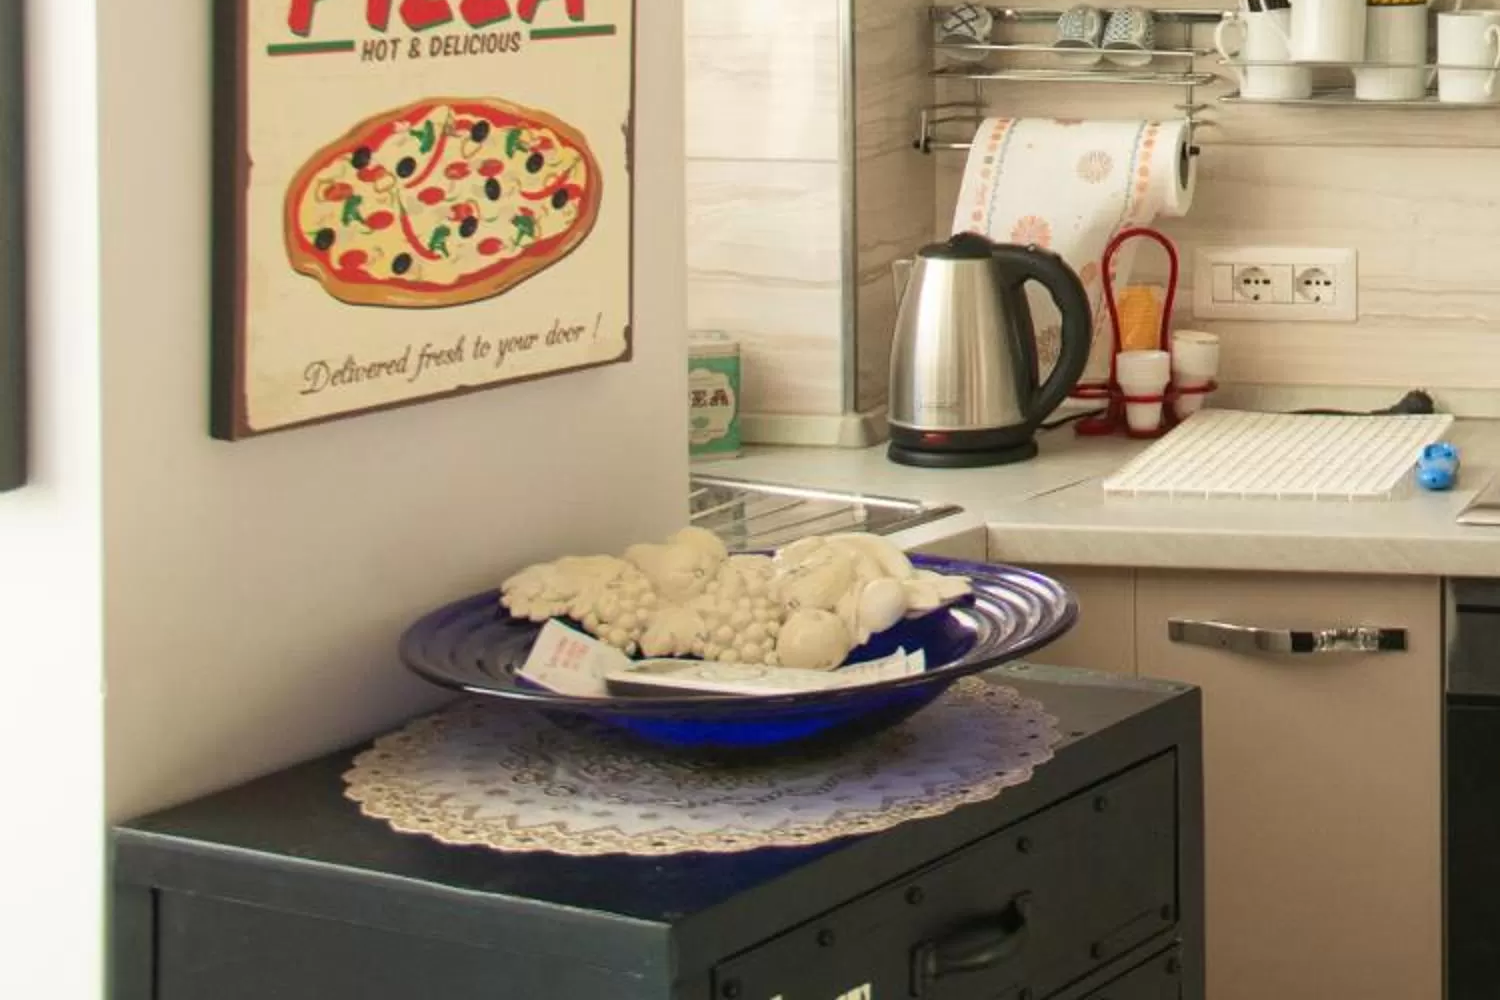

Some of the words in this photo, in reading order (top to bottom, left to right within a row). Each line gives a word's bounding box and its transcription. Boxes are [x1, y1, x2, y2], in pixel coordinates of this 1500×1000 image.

[361, 37, 402, 62] HOT
[408, 36, 422, 59] &
[429, 31, 522, 57] DELICIOUS
[299, 344, 412, 396] Delivered
[407, 335, 466, 383] fresh
[471, 335, 491, 360] to
[495, 334, 539, 368] your
[688, 387, 729, 408] EA
